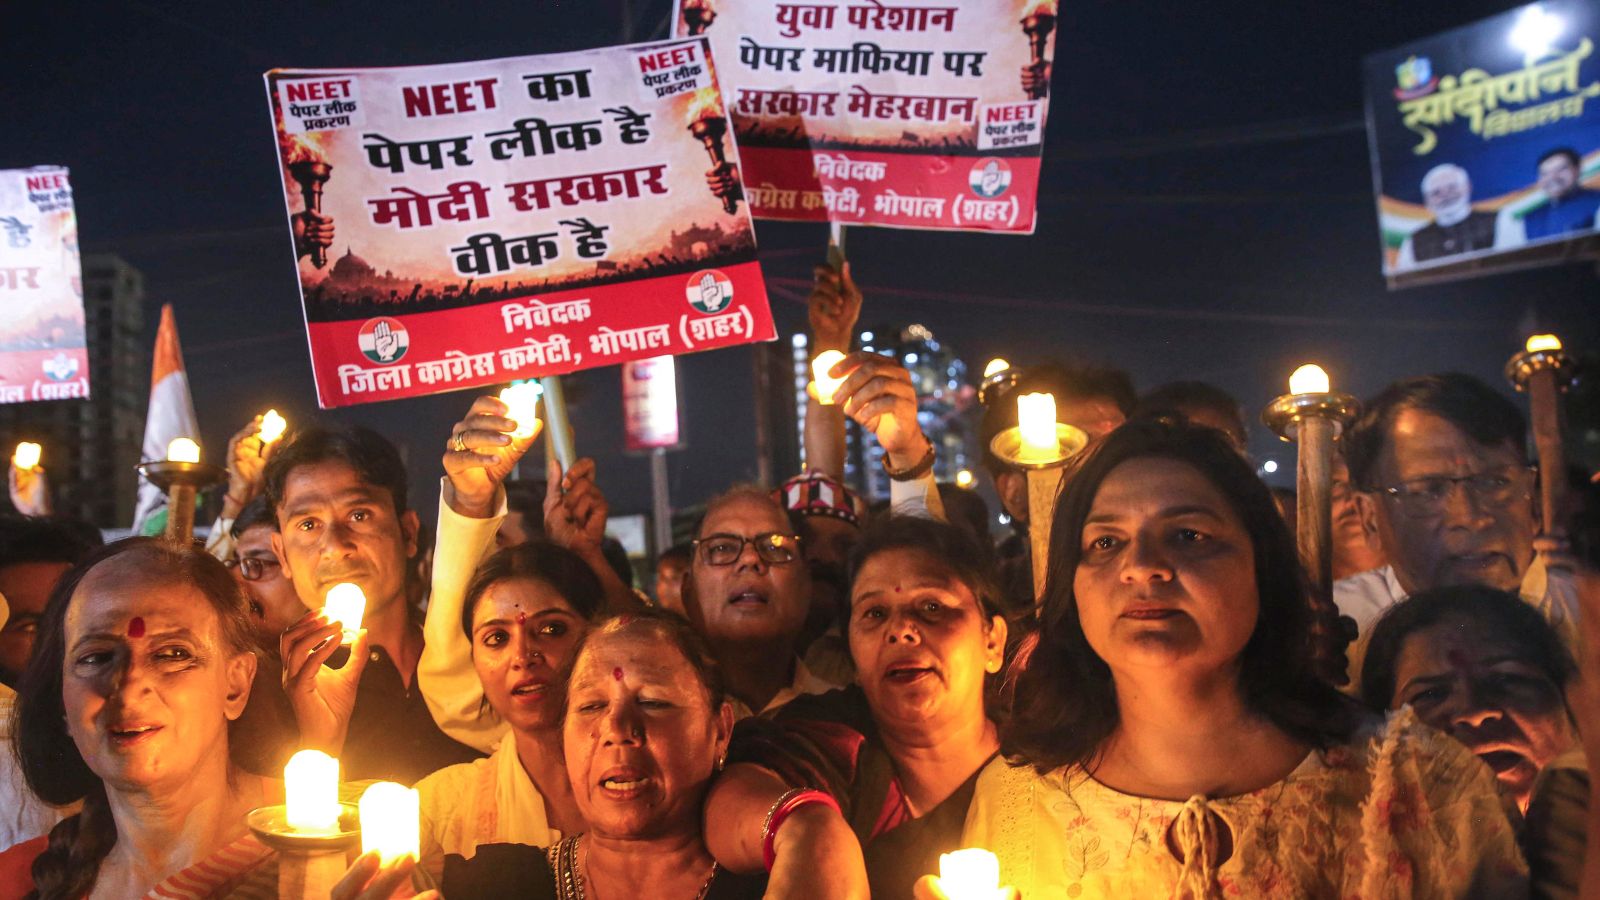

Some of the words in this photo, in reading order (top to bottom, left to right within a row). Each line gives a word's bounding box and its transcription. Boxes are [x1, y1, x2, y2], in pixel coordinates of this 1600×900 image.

[776, 4, 839, 38] युवा
[847, 0, 958, 32] परेशान
[639, 45, 695, 73] NEET
[740, 37, 805, 71] पेपर
[813, 42, 934, 76] माफिया
[943, 51, 987, 77] पर
[286, 80, 351, 101] NEET
[402, 78, 498, 117] NEET
[522, 68, 592, 102] का
[643, 73, 670, 88] पेपर
[672, 64, 702, 80] लीक
[656, 79, 697, 98] प्रकरण
[289, 103, 321, 118] पेपर
[323, 99, 356, 115] लीक
[738, 88, 840, 116] सरकार
[848, 84, 978, 122] मेहरबान
[987, 103, 1036, 122] NEET
[303, 115, 350, 131] प्रकरण
[363, 133, 473, 173] पेपर
[485, 117, 602, 160] लीक
[602, 105, 651, 144] है
[813, 153, 887, 181] निवेदक
[367, 181, 491, 228] मोदी
[505, 164, 669, 211] सरकार
[803, 185, 865, 217] कमेटी,
[874, 189, 946, 219] भोपाल
[951, 193, 1019, 228] (शहर)
[451, 232, 558, 275] वीक
[558, 217, 609, 258] है
[501, 298, 591, 334] निवेदक
[338, 363, 412, 395] जिला
[499, 333, 582, 371] कमेटी,
[588, 323, 671, 356] भोपाल
[679, 304, 754, 349] (शहर)
